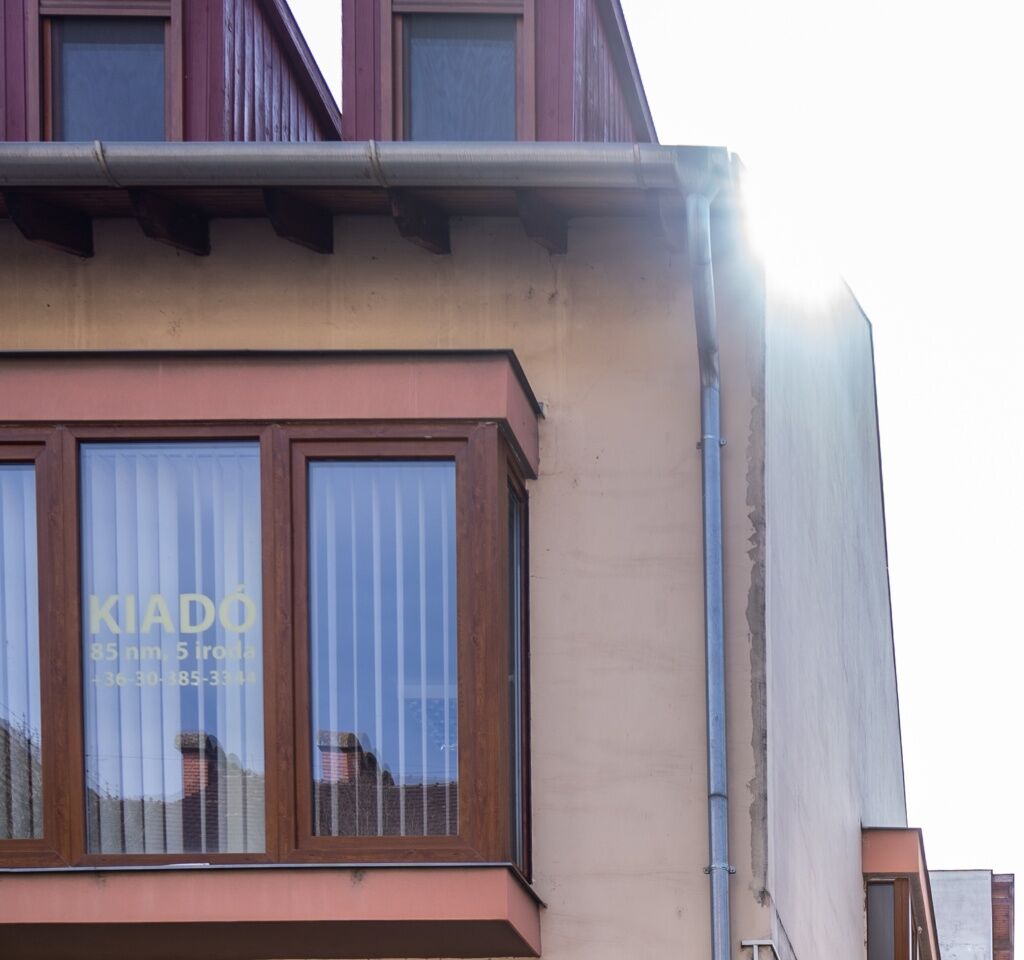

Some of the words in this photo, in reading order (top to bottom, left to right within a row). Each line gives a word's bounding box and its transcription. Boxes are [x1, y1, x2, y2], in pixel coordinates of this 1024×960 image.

[89, 583, 257, 634] KIADÓ
[90, 642, 118, 661] 85
[176, 641, 189, 660] 5
[195, 640, 256, 660] iroda
